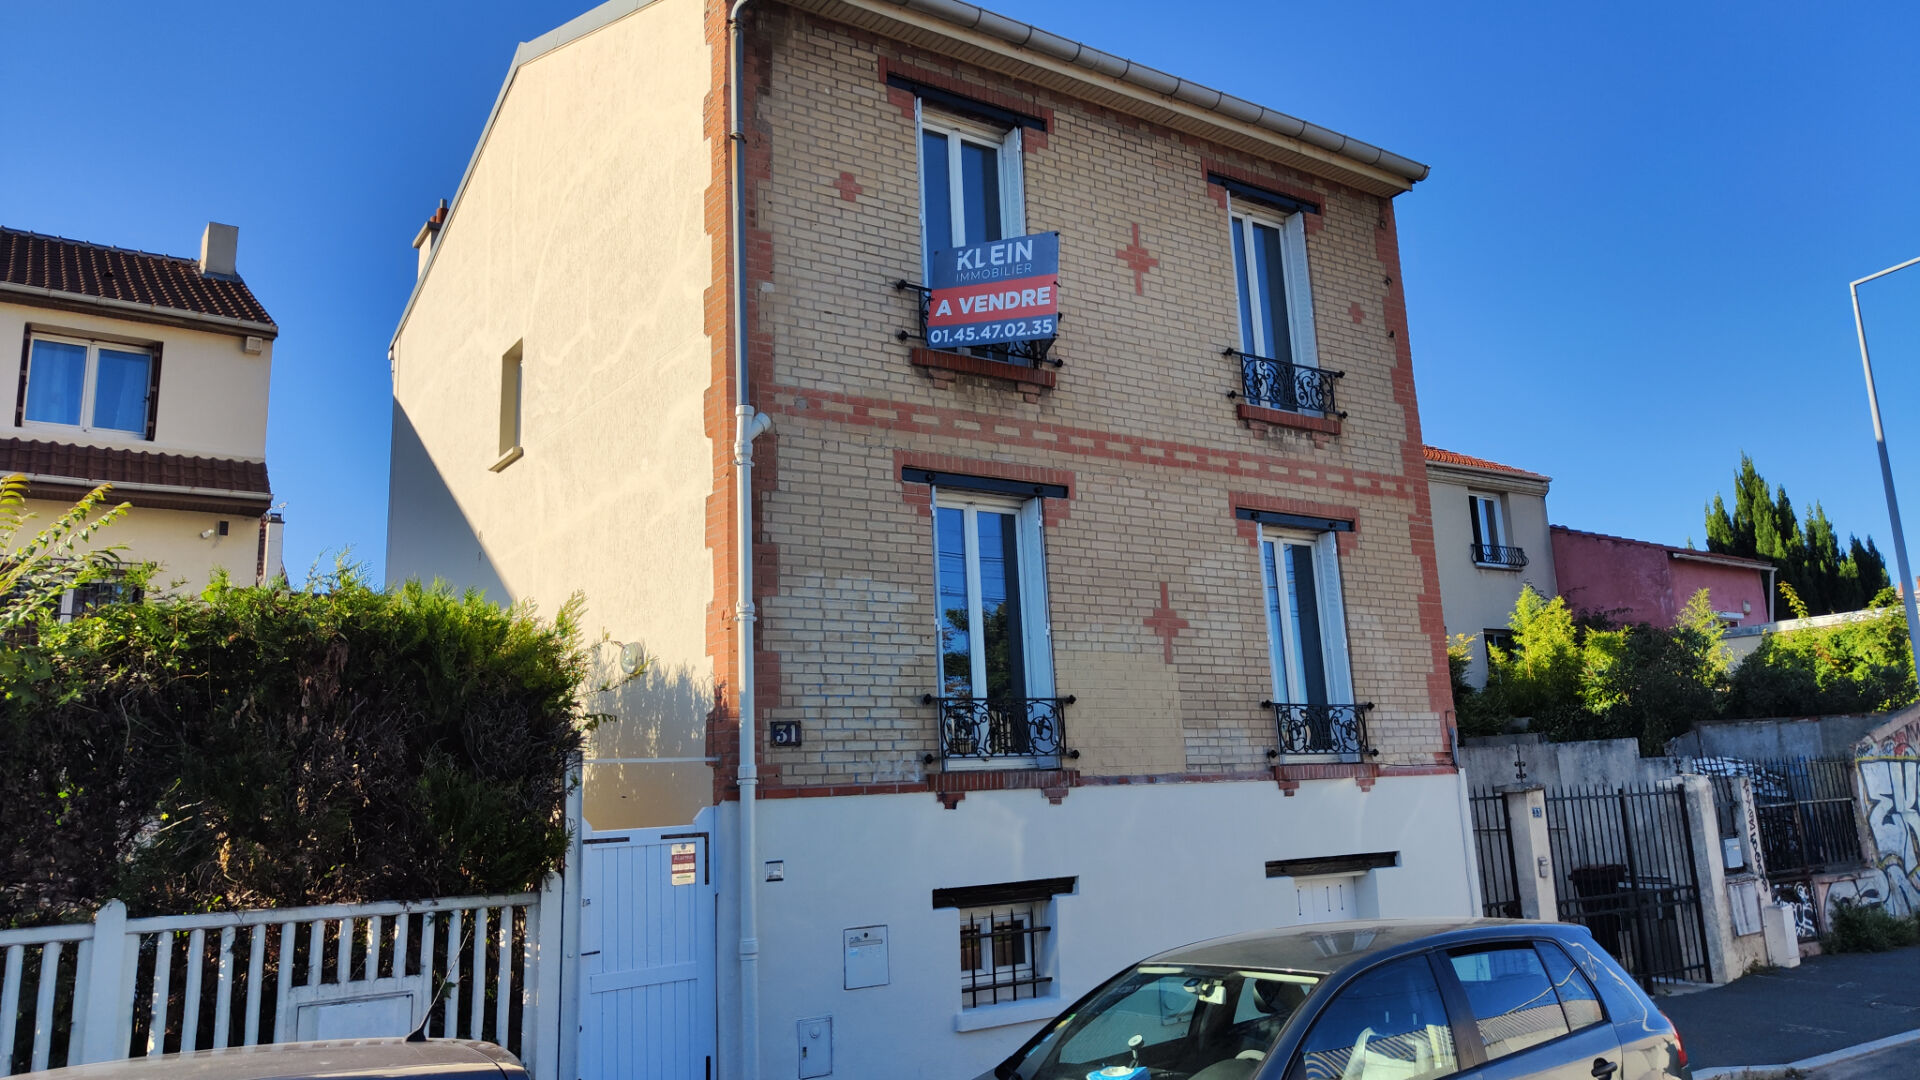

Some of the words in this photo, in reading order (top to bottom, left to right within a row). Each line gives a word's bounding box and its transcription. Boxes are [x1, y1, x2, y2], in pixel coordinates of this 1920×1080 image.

[957, 239, 1033, 271] KLEIN
[956, 262, 1032, 282] IMMOBILIER
[935, 299, 952, 317] A
[959, 286, 1051, 314] VENDRE
[930, 318, 1053, 343] 01.45.47.02.35
[776, 724, 796, 743] 31
